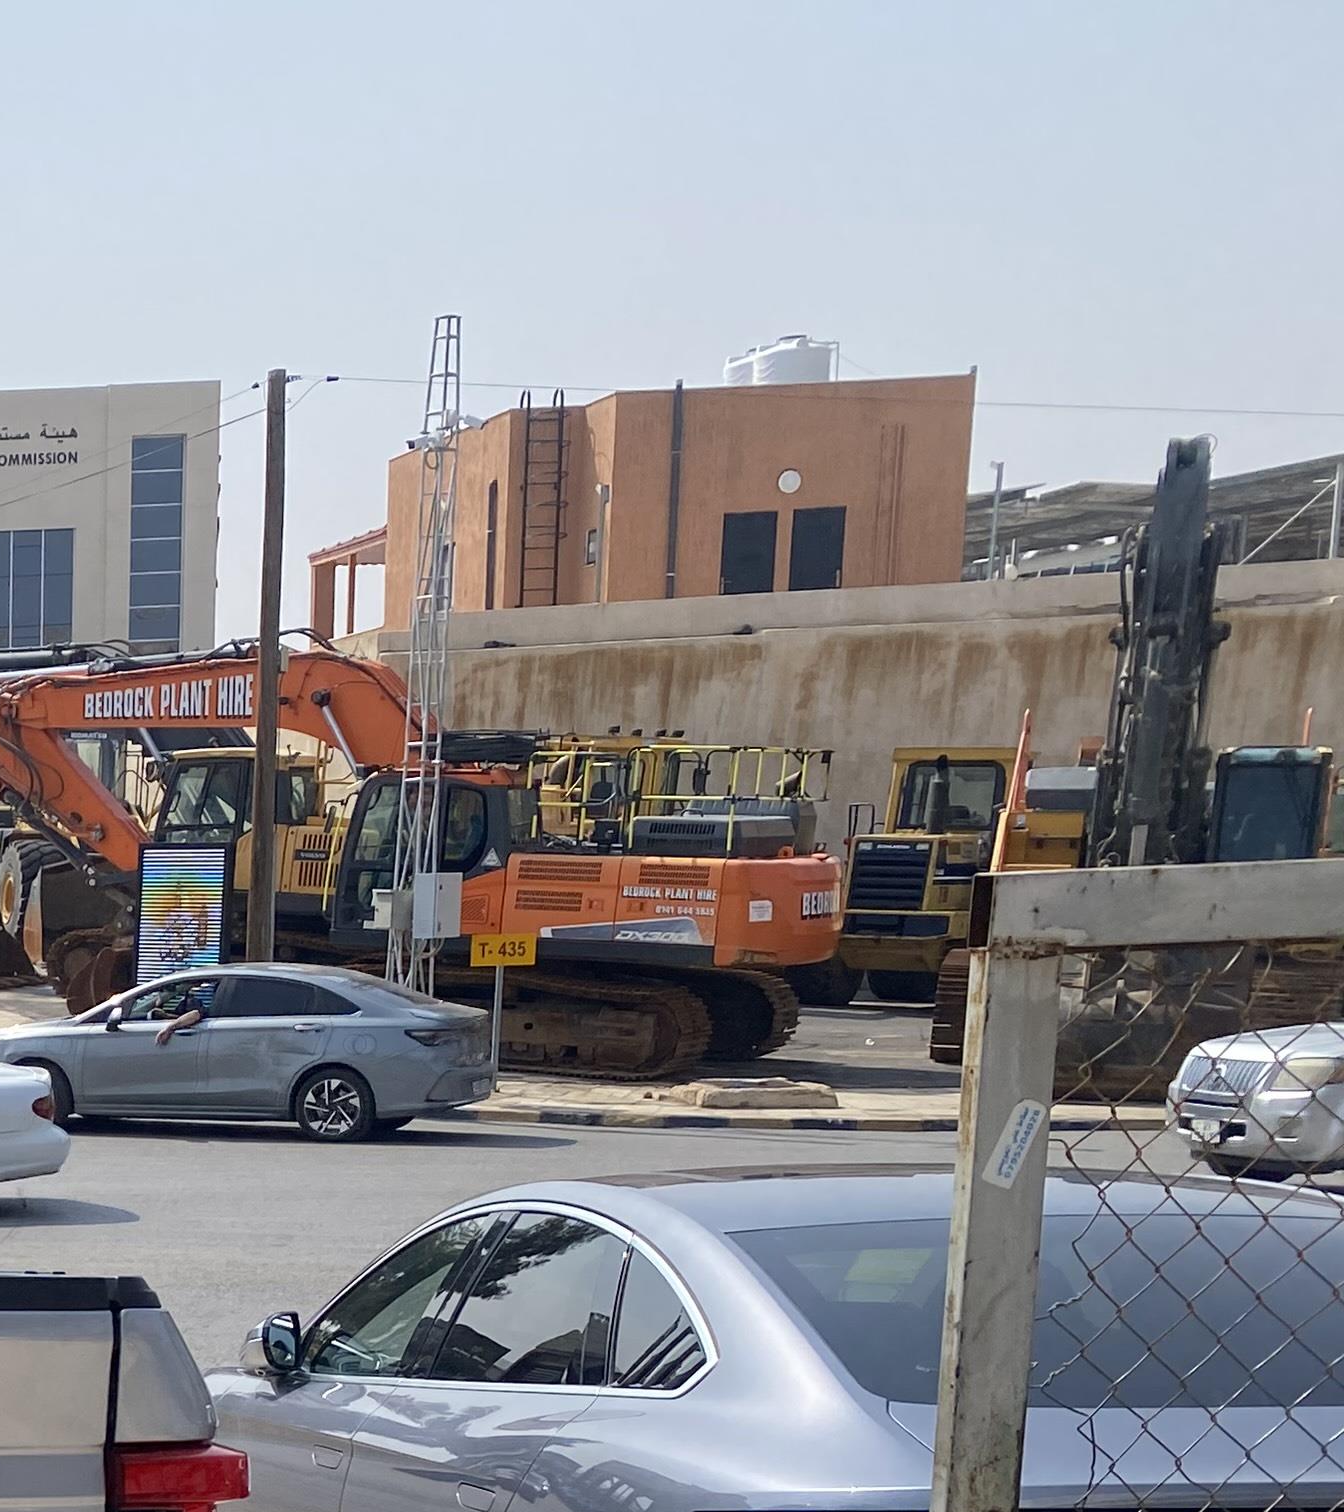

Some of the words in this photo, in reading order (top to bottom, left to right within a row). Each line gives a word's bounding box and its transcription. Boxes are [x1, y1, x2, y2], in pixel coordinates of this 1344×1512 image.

[84, 685, 154, 718] BEDROCK
[159, 678, 212, 718] PLANT
[217, 673, 254, 717] HIRE
[665, 887, 693, 900] PLANT
[696, 888, 717, 901] HIRE
[498, 941, 526, 957] 435
